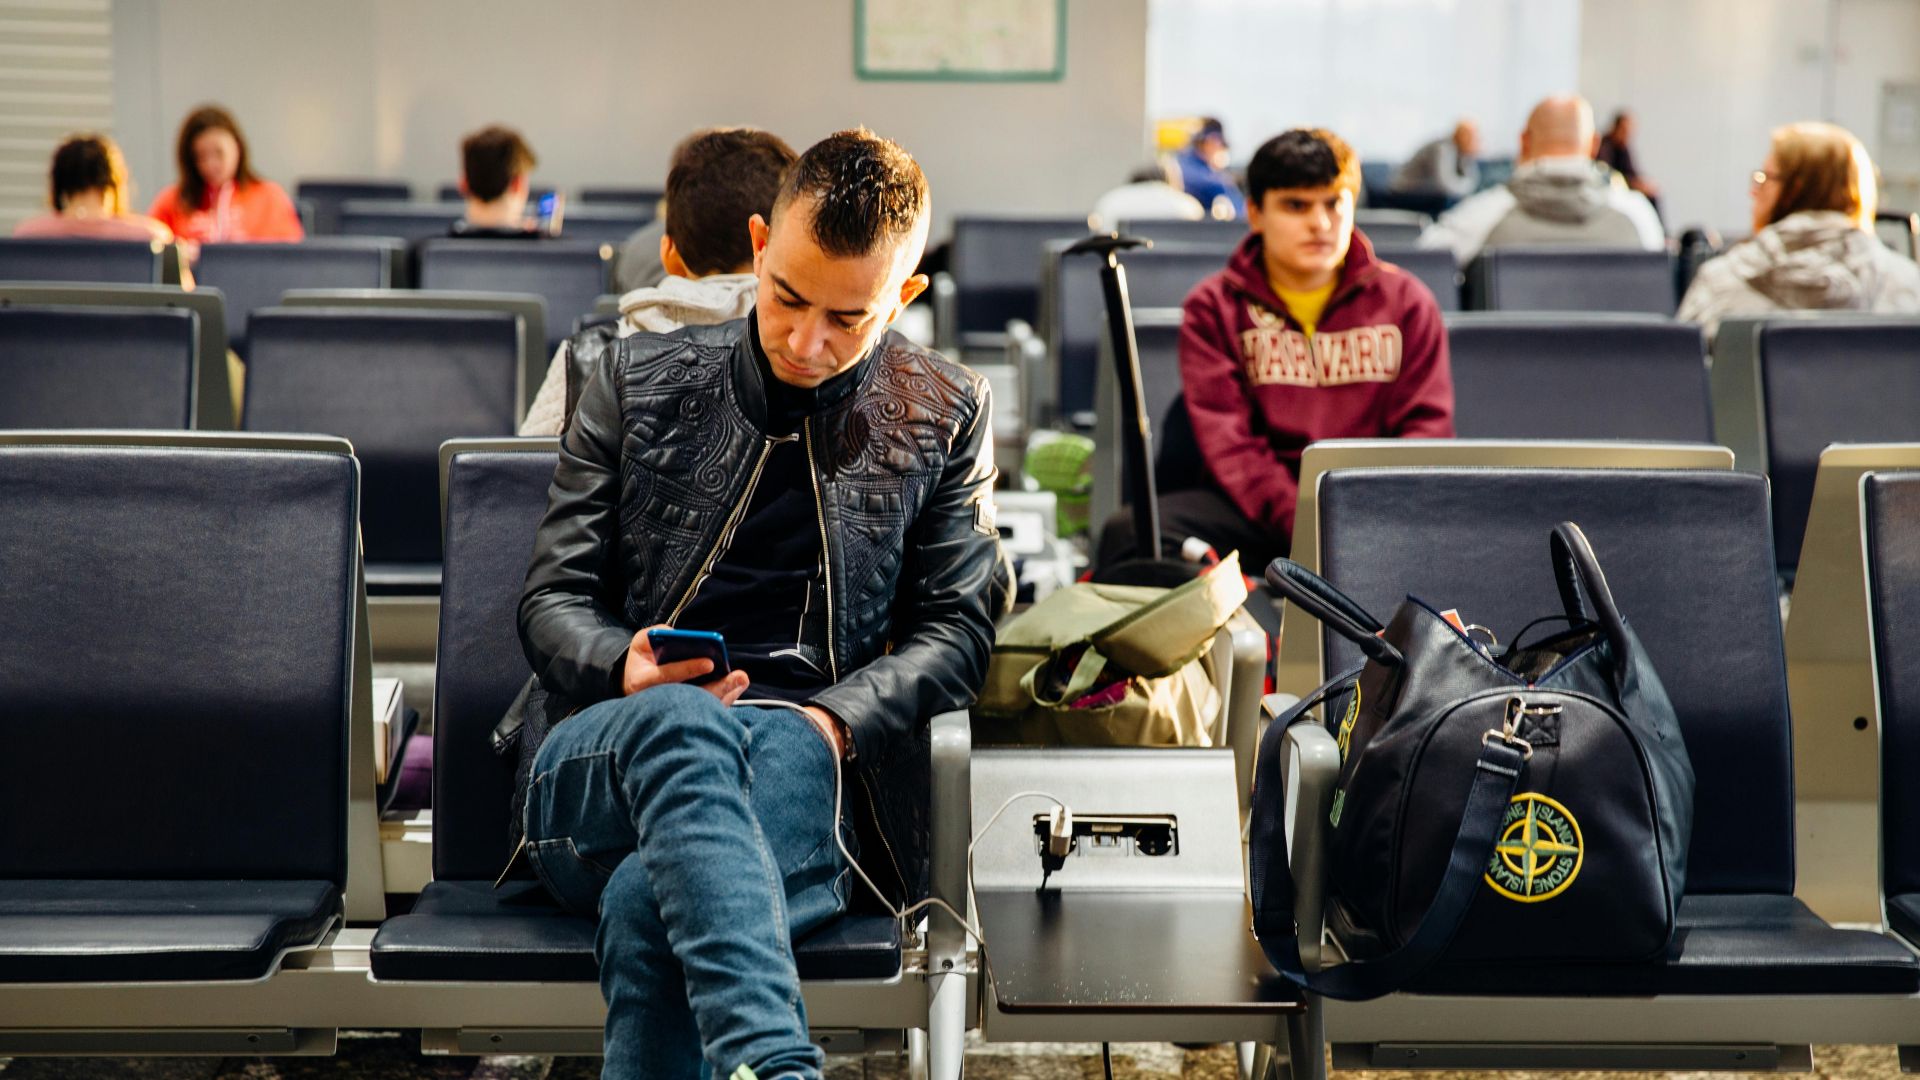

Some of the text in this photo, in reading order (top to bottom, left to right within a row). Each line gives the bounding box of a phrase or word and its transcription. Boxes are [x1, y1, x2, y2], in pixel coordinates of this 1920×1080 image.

[1242, 324, 1403, 388] HARVARD
[1503, 802, 1574, 845] ONE ISLAND
[1489, 852, 1573, 894] STONE ISLAN
